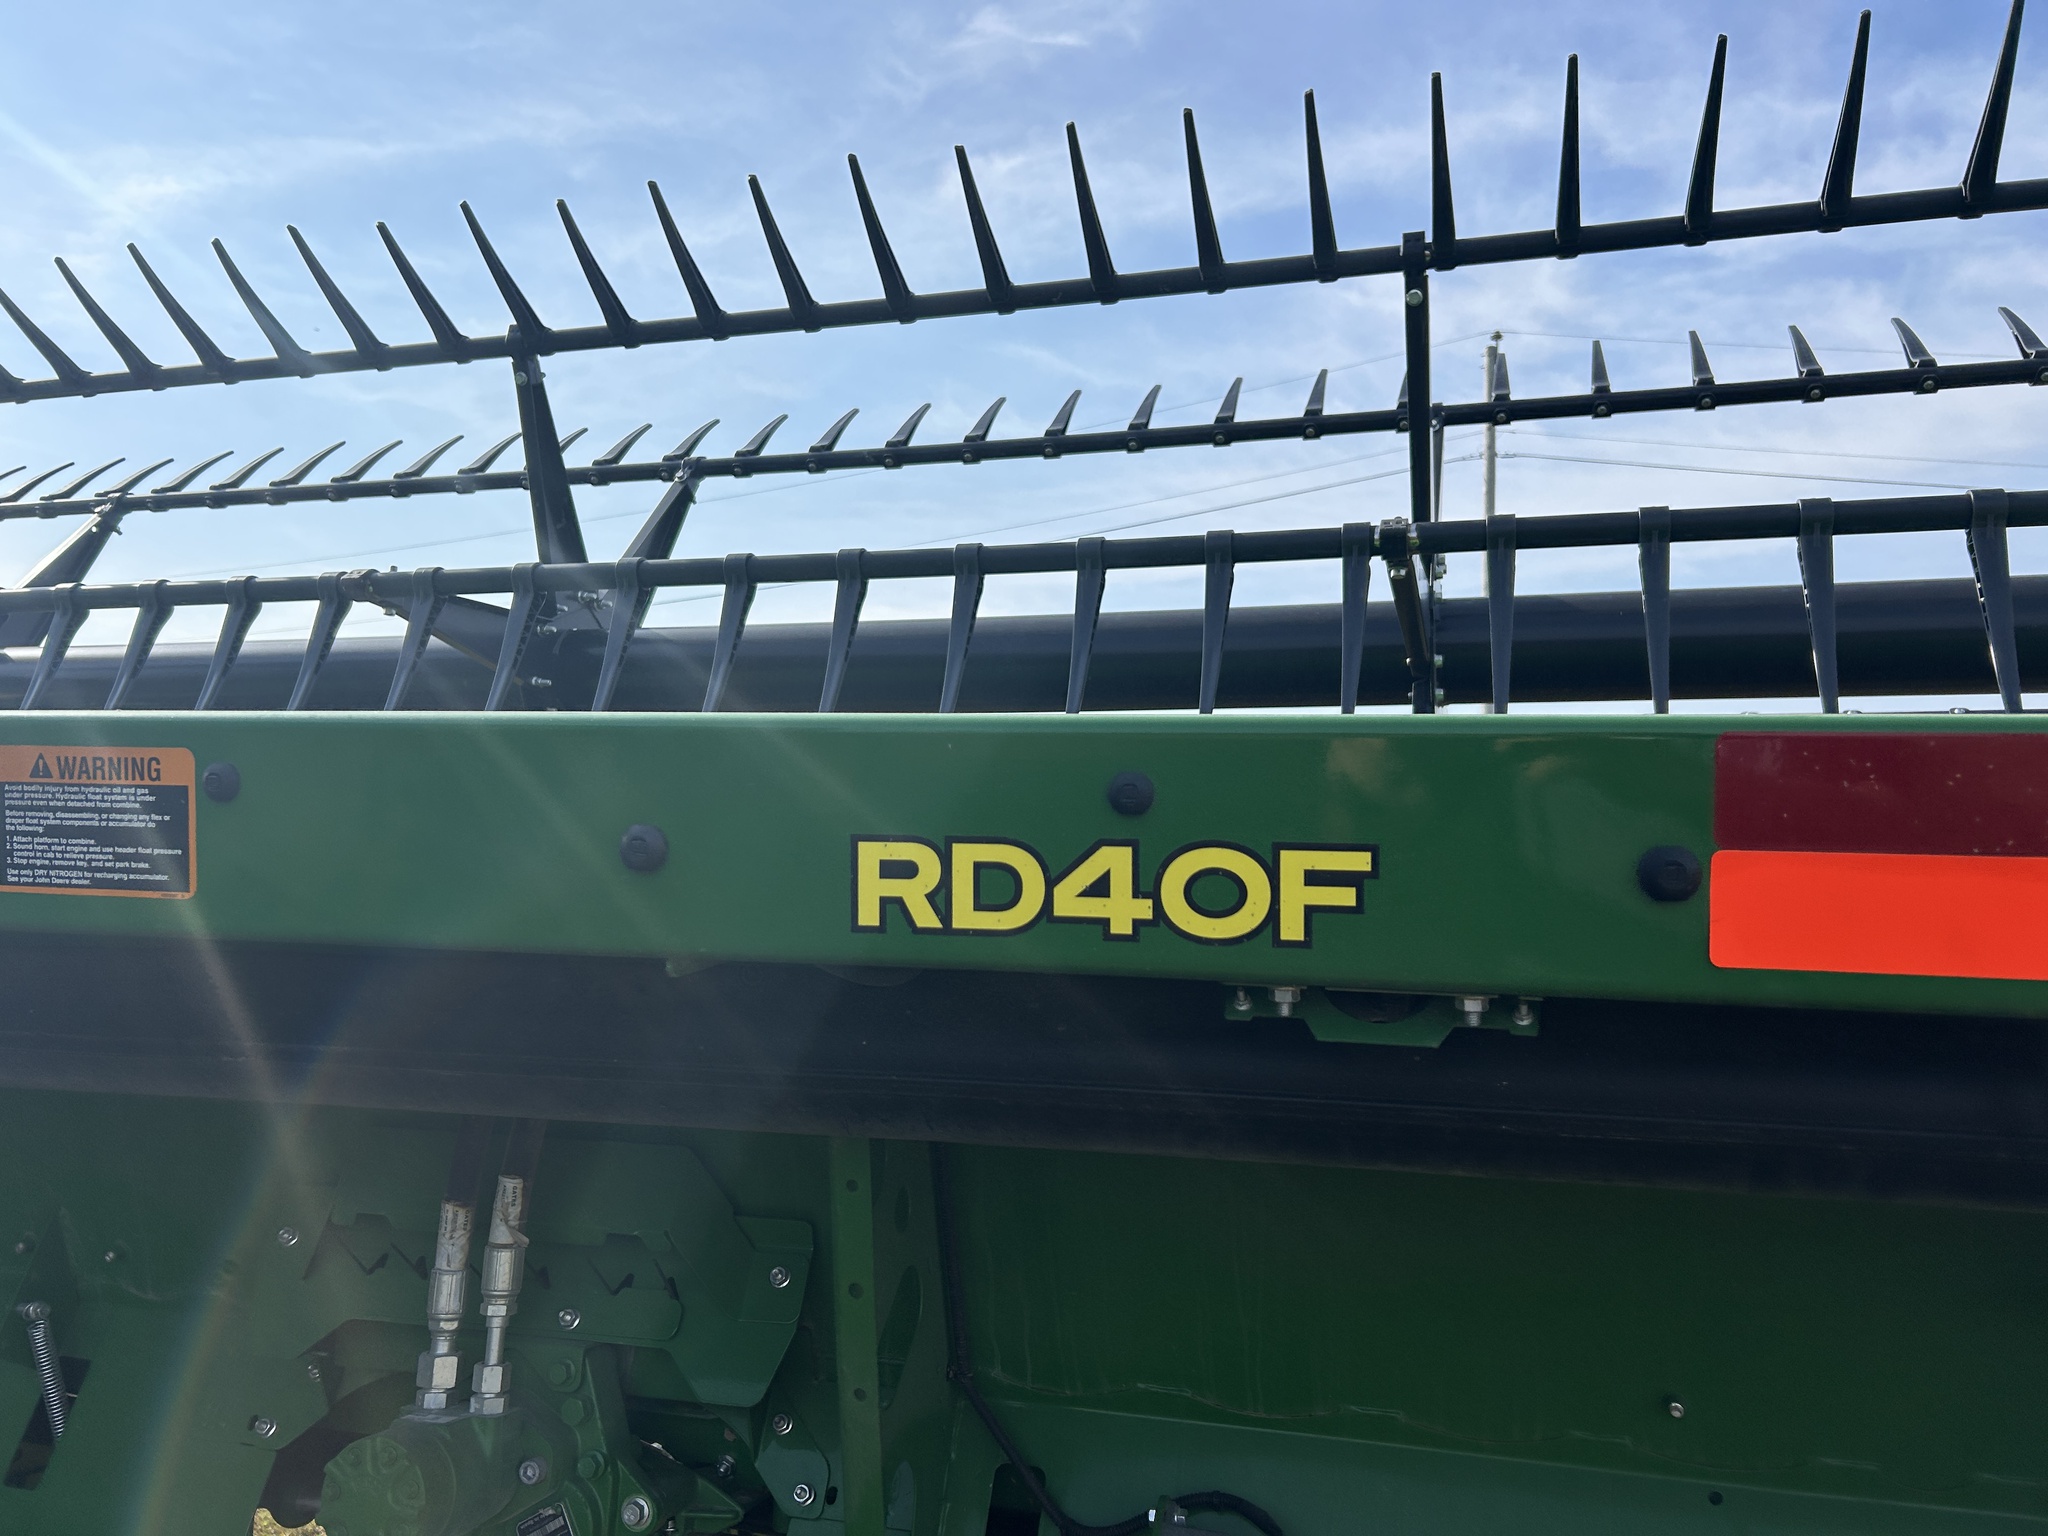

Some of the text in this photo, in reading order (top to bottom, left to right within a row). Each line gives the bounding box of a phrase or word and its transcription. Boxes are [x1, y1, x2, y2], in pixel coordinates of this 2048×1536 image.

[56, 756, 161, 782] WARNING
[94, 872, 127, 880] recharging
[856, 839, 1374, 943] RD40F
